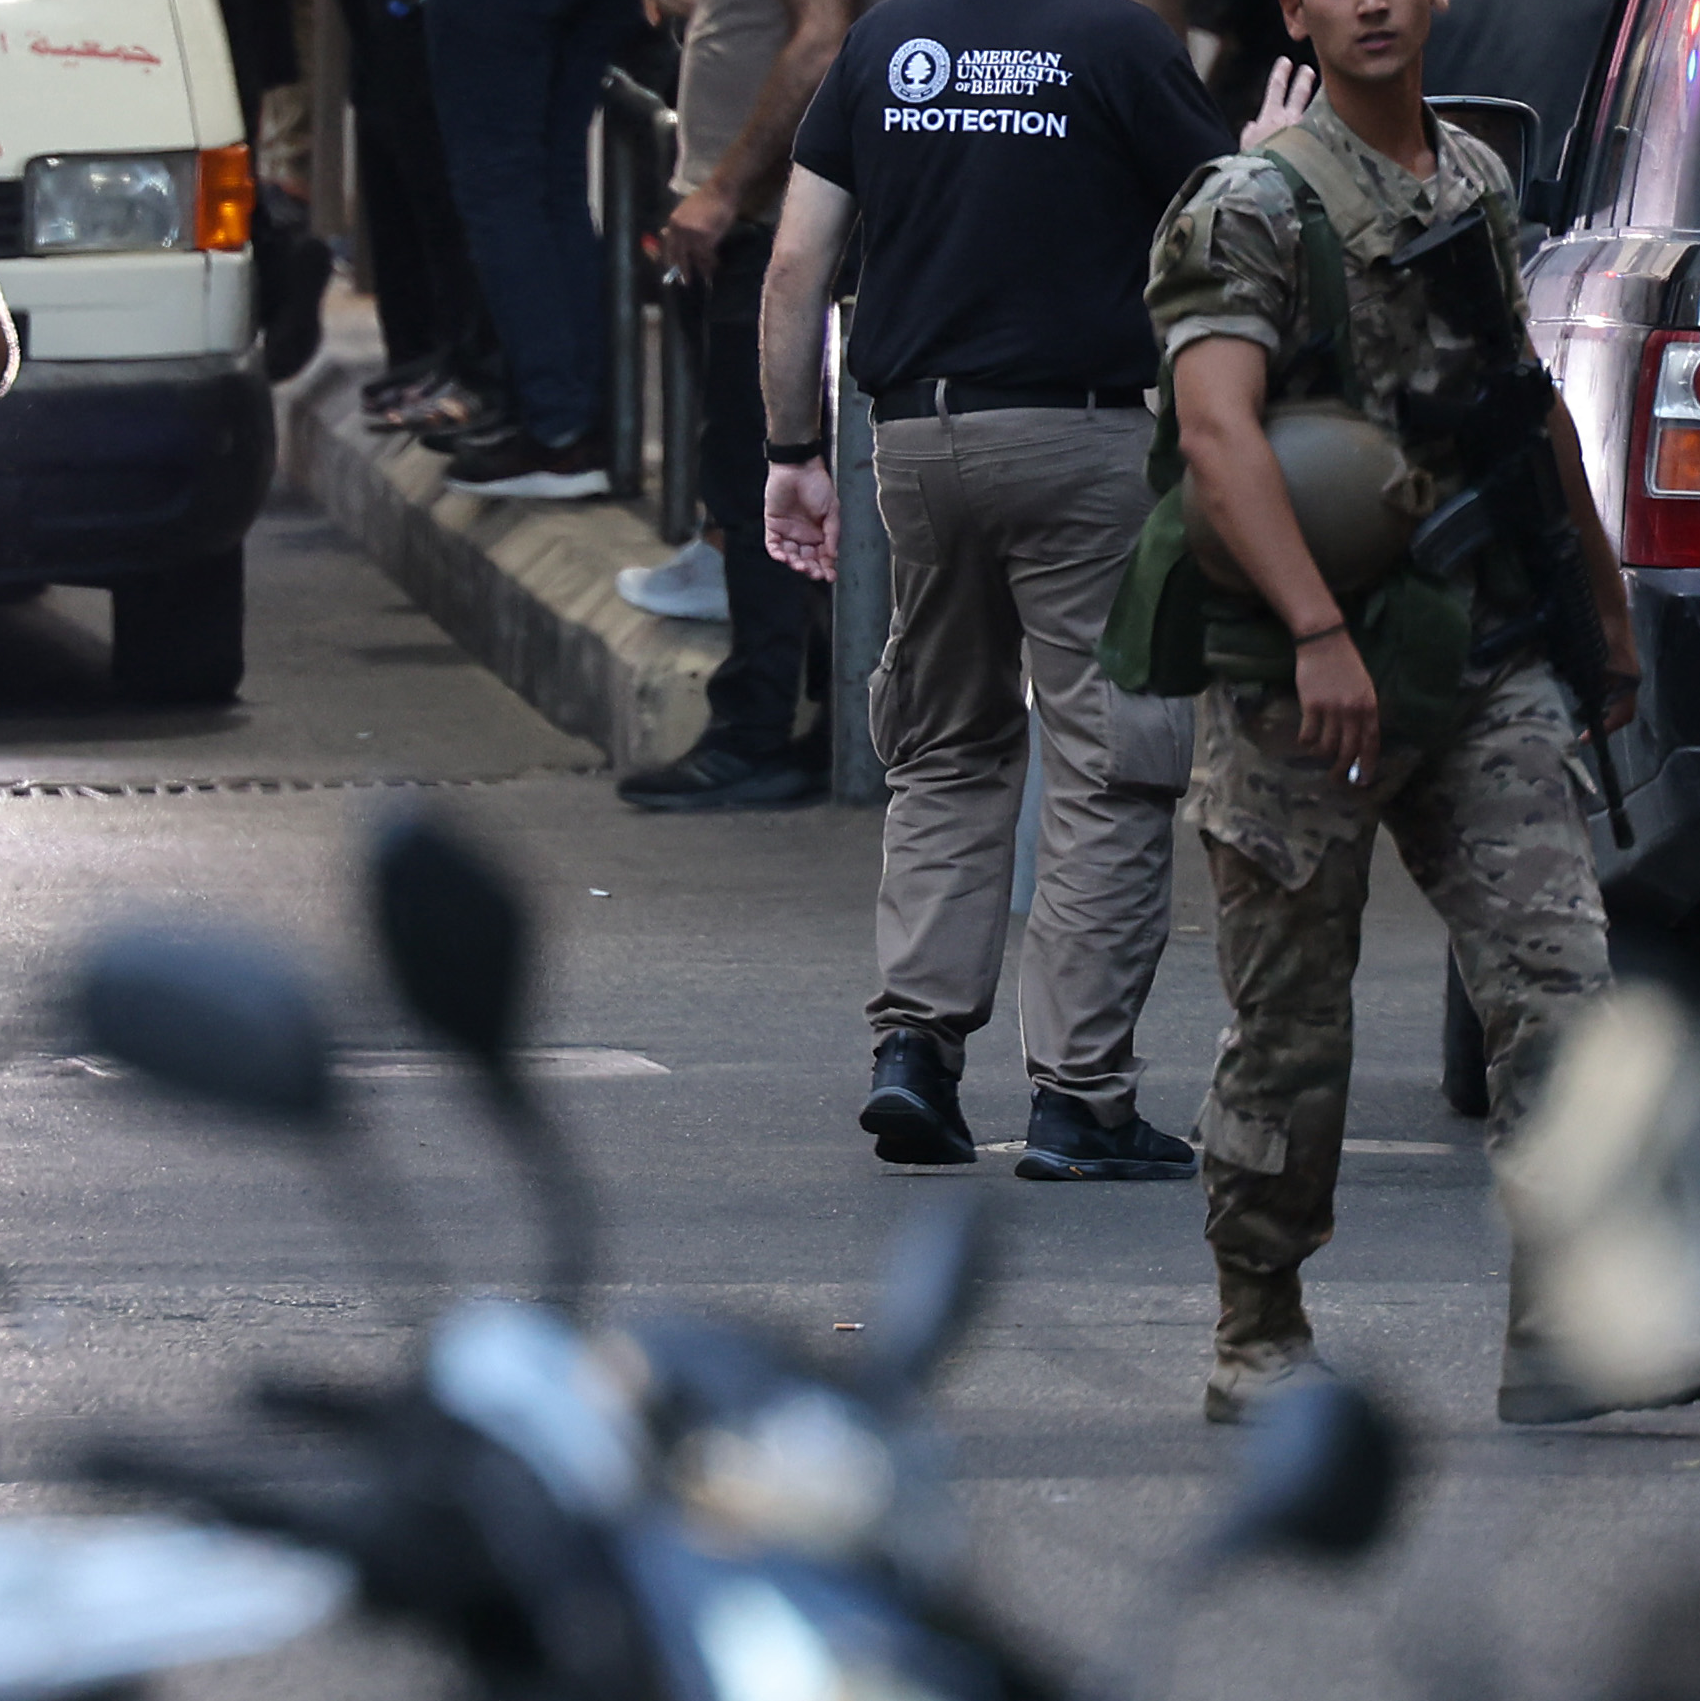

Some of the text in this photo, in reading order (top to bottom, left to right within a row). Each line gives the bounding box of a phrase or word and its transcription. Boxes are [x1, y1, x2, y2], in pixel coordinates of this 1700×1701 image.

[957, 51, 1062, 68] AMERICAN
[957, 65, 1073, 86] UNIVERSITY
[970, 80, 1038, 95] BEIRUT
[884, 107, 1067, 138] PROTECTION
